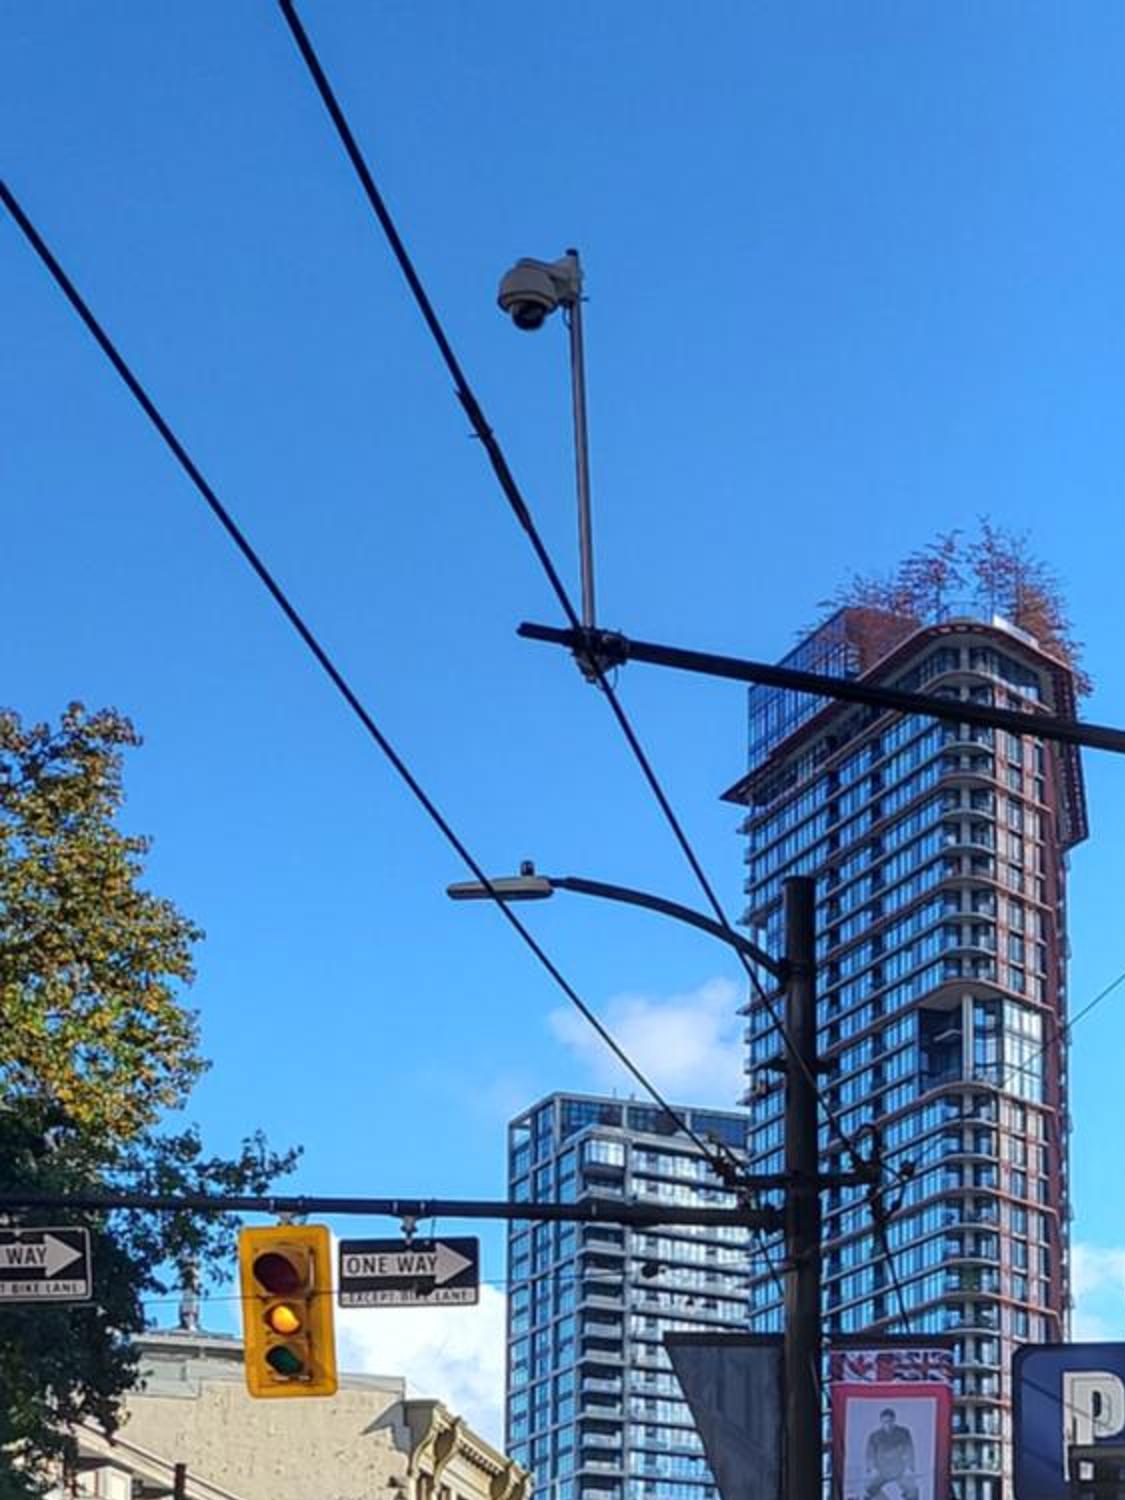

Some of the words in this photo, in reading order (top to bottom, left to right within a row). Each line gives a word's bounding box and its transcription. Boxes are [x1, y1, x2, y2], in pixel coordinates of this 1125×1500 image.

[5, 1247, 47, 1264] WAY
[347, 1257, 388, 1275] ONE
[397, 1255, 437, 1273] WAY
